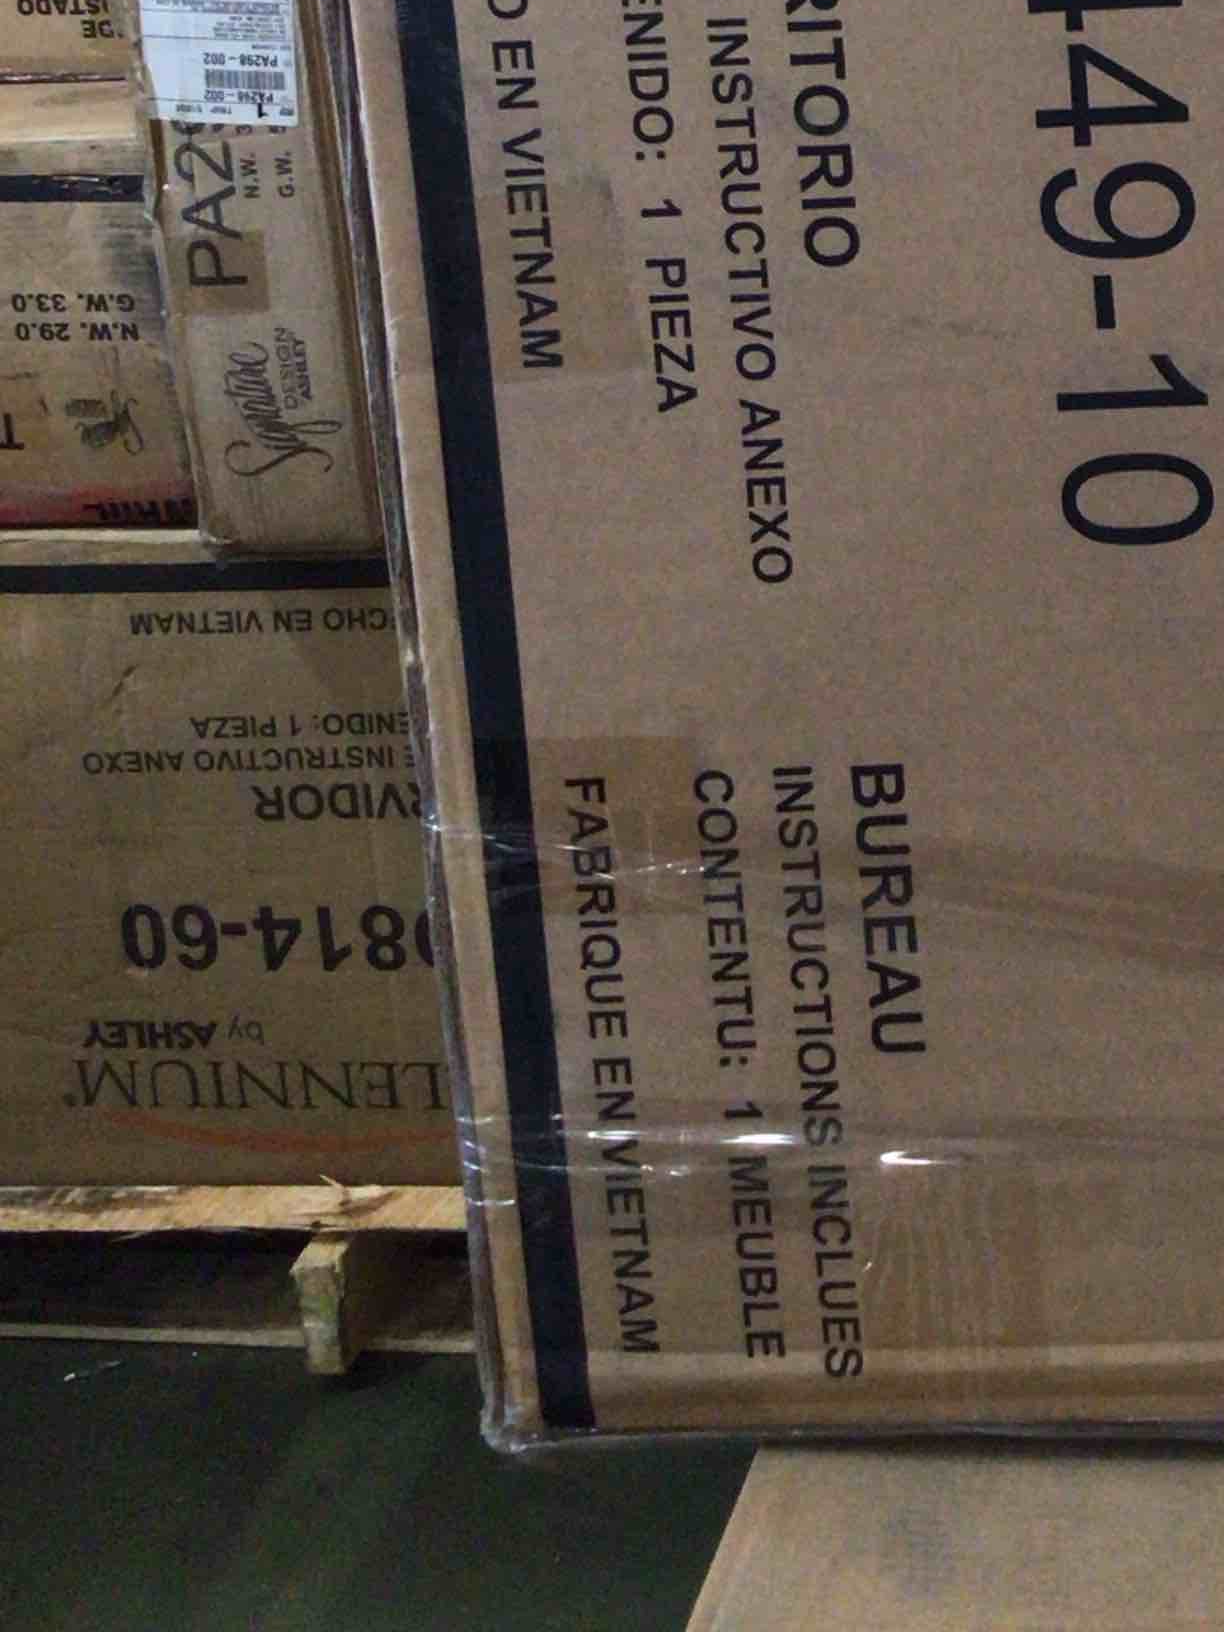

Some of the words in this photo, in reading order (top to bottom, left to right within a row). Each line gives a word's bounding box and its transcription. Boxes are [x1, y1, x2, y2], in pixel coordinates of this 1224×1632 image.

[493, 40, 539, 110] EN
[640, 200, 683, 218] 1
[706, 17, 778, 381] INSTRUCTIVO
[502, 128, 563, 368] VIETNAM
[11, 293, 67, 313] 33.0
[77, 293, 136, 313] G.W.
[15, 321, 70, 342] 29.0
[79, 321, 140, 342] N.W.
[645, 258, 698, 413] PIEZA
[739, 398, 793, 585] ANEXO
[129, 610, 261, 635] VIETNAM
[274, 610, 314, 633] EN
[323, 608, 395, 632] CHO
[189, 716, 276, 740] PIEZA
[289, 713, 301, 737] 1
[82, 749, 185, 775] ANEXO
[193, 745, 394, 773] INSTRUCTIVO
[564, 777, 628, 1041] FABRIQUE
[694, 771, 757, 1068] CONTENTU:
[850, 763, 926, 1056] BUREAU
[773, 766, 844, 1148] INSTRUCTIONS
[84, 1019, 218, 1049] ASHLEY
[592, 1058, 636, 1122] EN
[724, 1100, 764, 1120] 1
[600, 1139, 661, 1356] VIETNAM
[728, 1154, 786, 1359] MEUBLE
[807, 1167, 863, 1379] INCLUES
